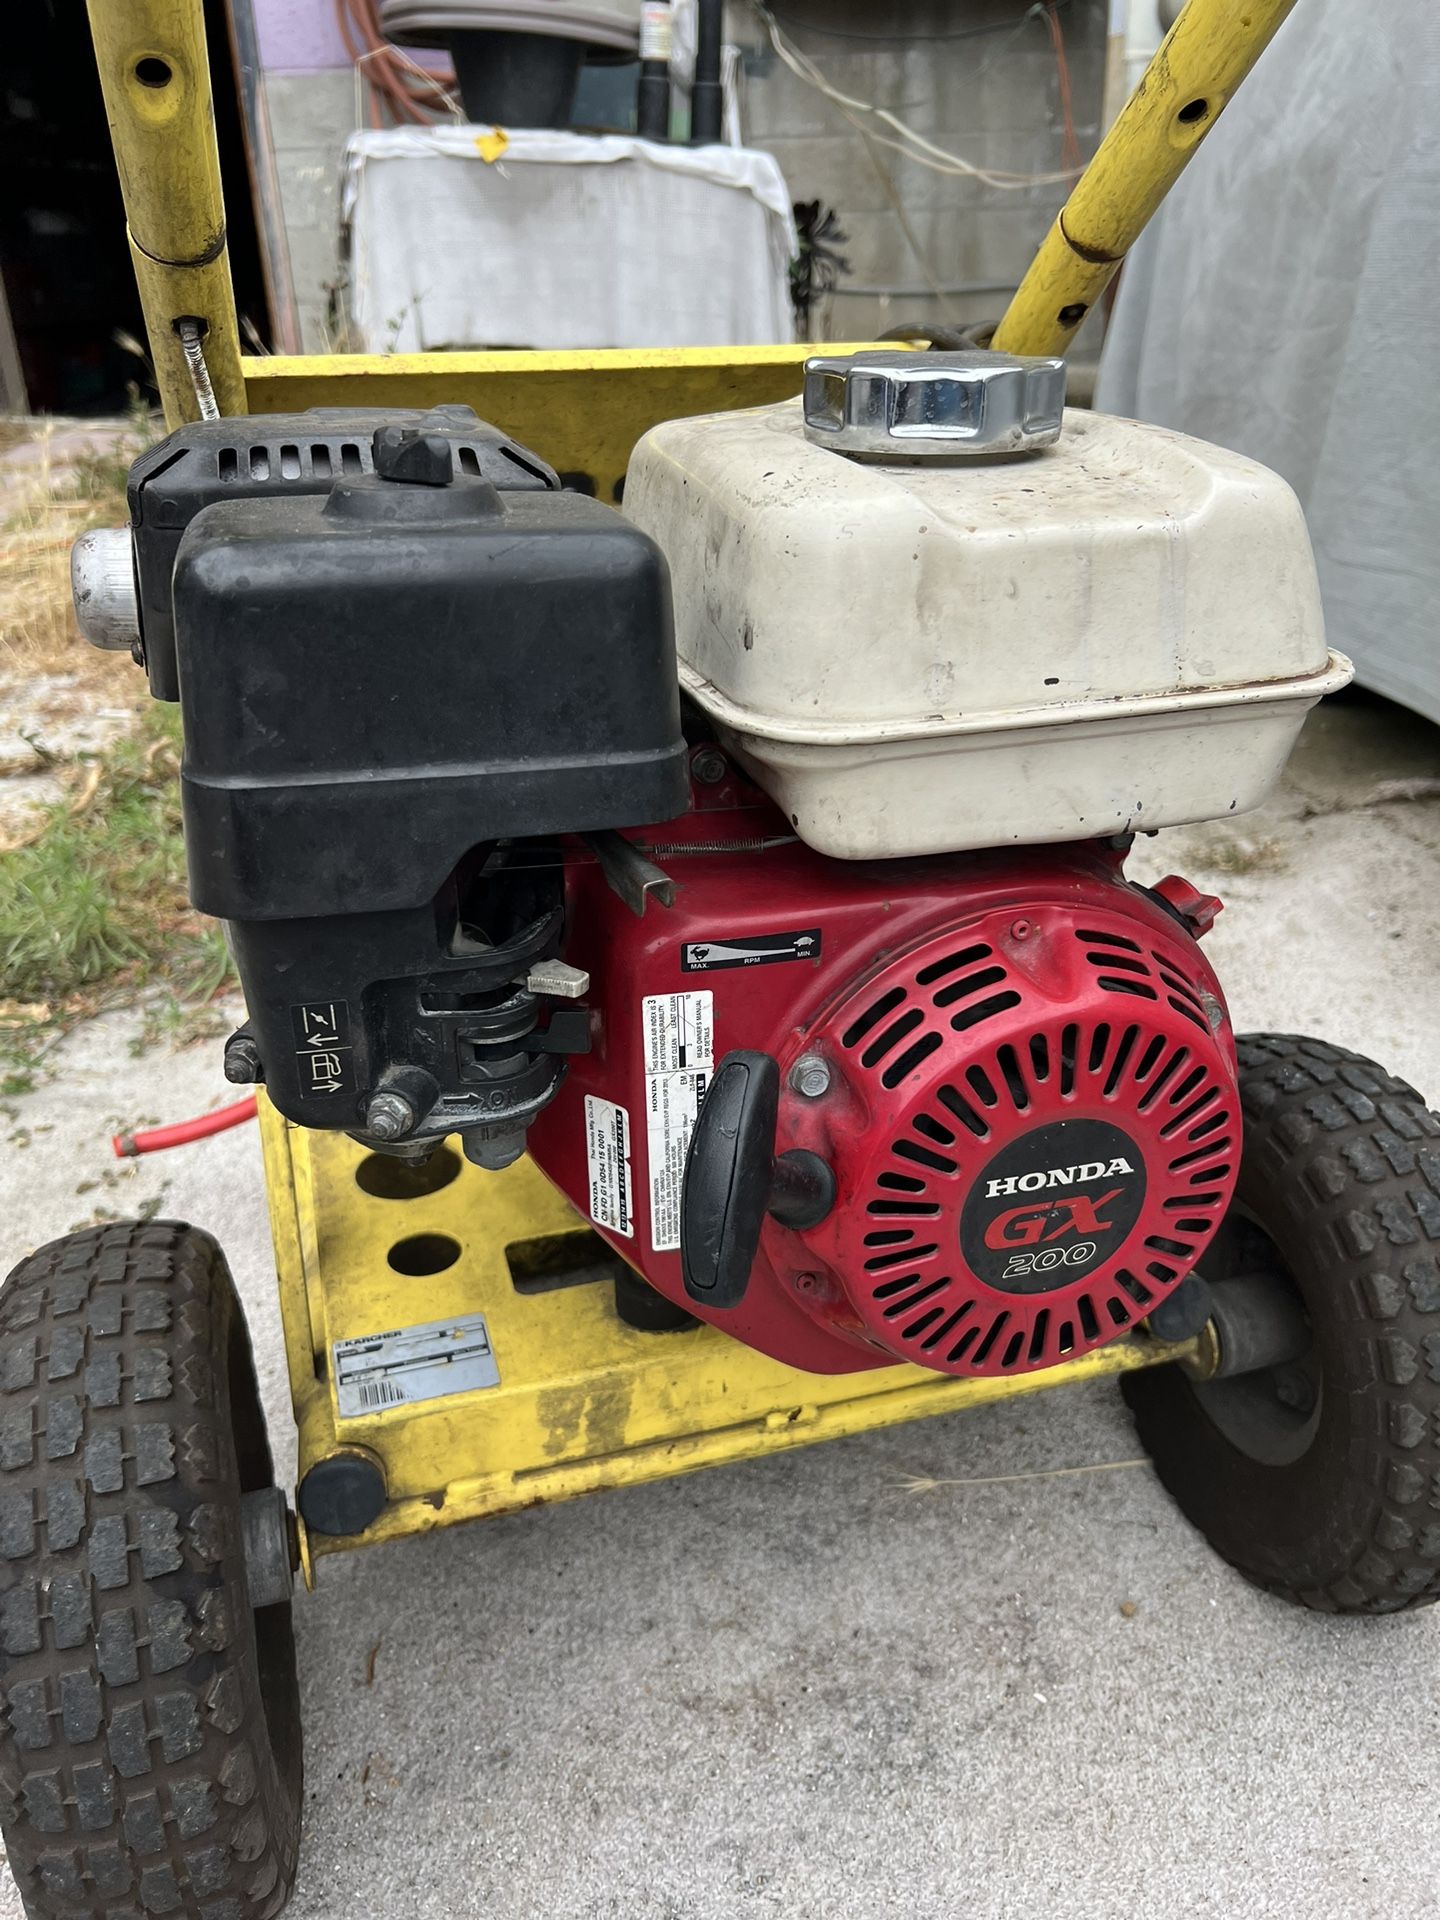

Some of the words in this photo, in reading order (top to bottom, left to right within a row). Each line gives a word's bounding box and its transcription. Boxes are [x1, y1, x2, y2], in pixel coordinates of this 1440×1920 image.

[680, 1076, 687, 1085] EM
[599, 1151, 605, 1160] 15
[985, 1158, 1134, 1198] HONDA
[600, 1186, 607, 1196] G1
[601, 1198, 607, 1208] FD
[601, 1210, 608, 1222] CN
[984, 1188, 1126, 1250] GX
[1002, 1242, 1096, 1278] 200
